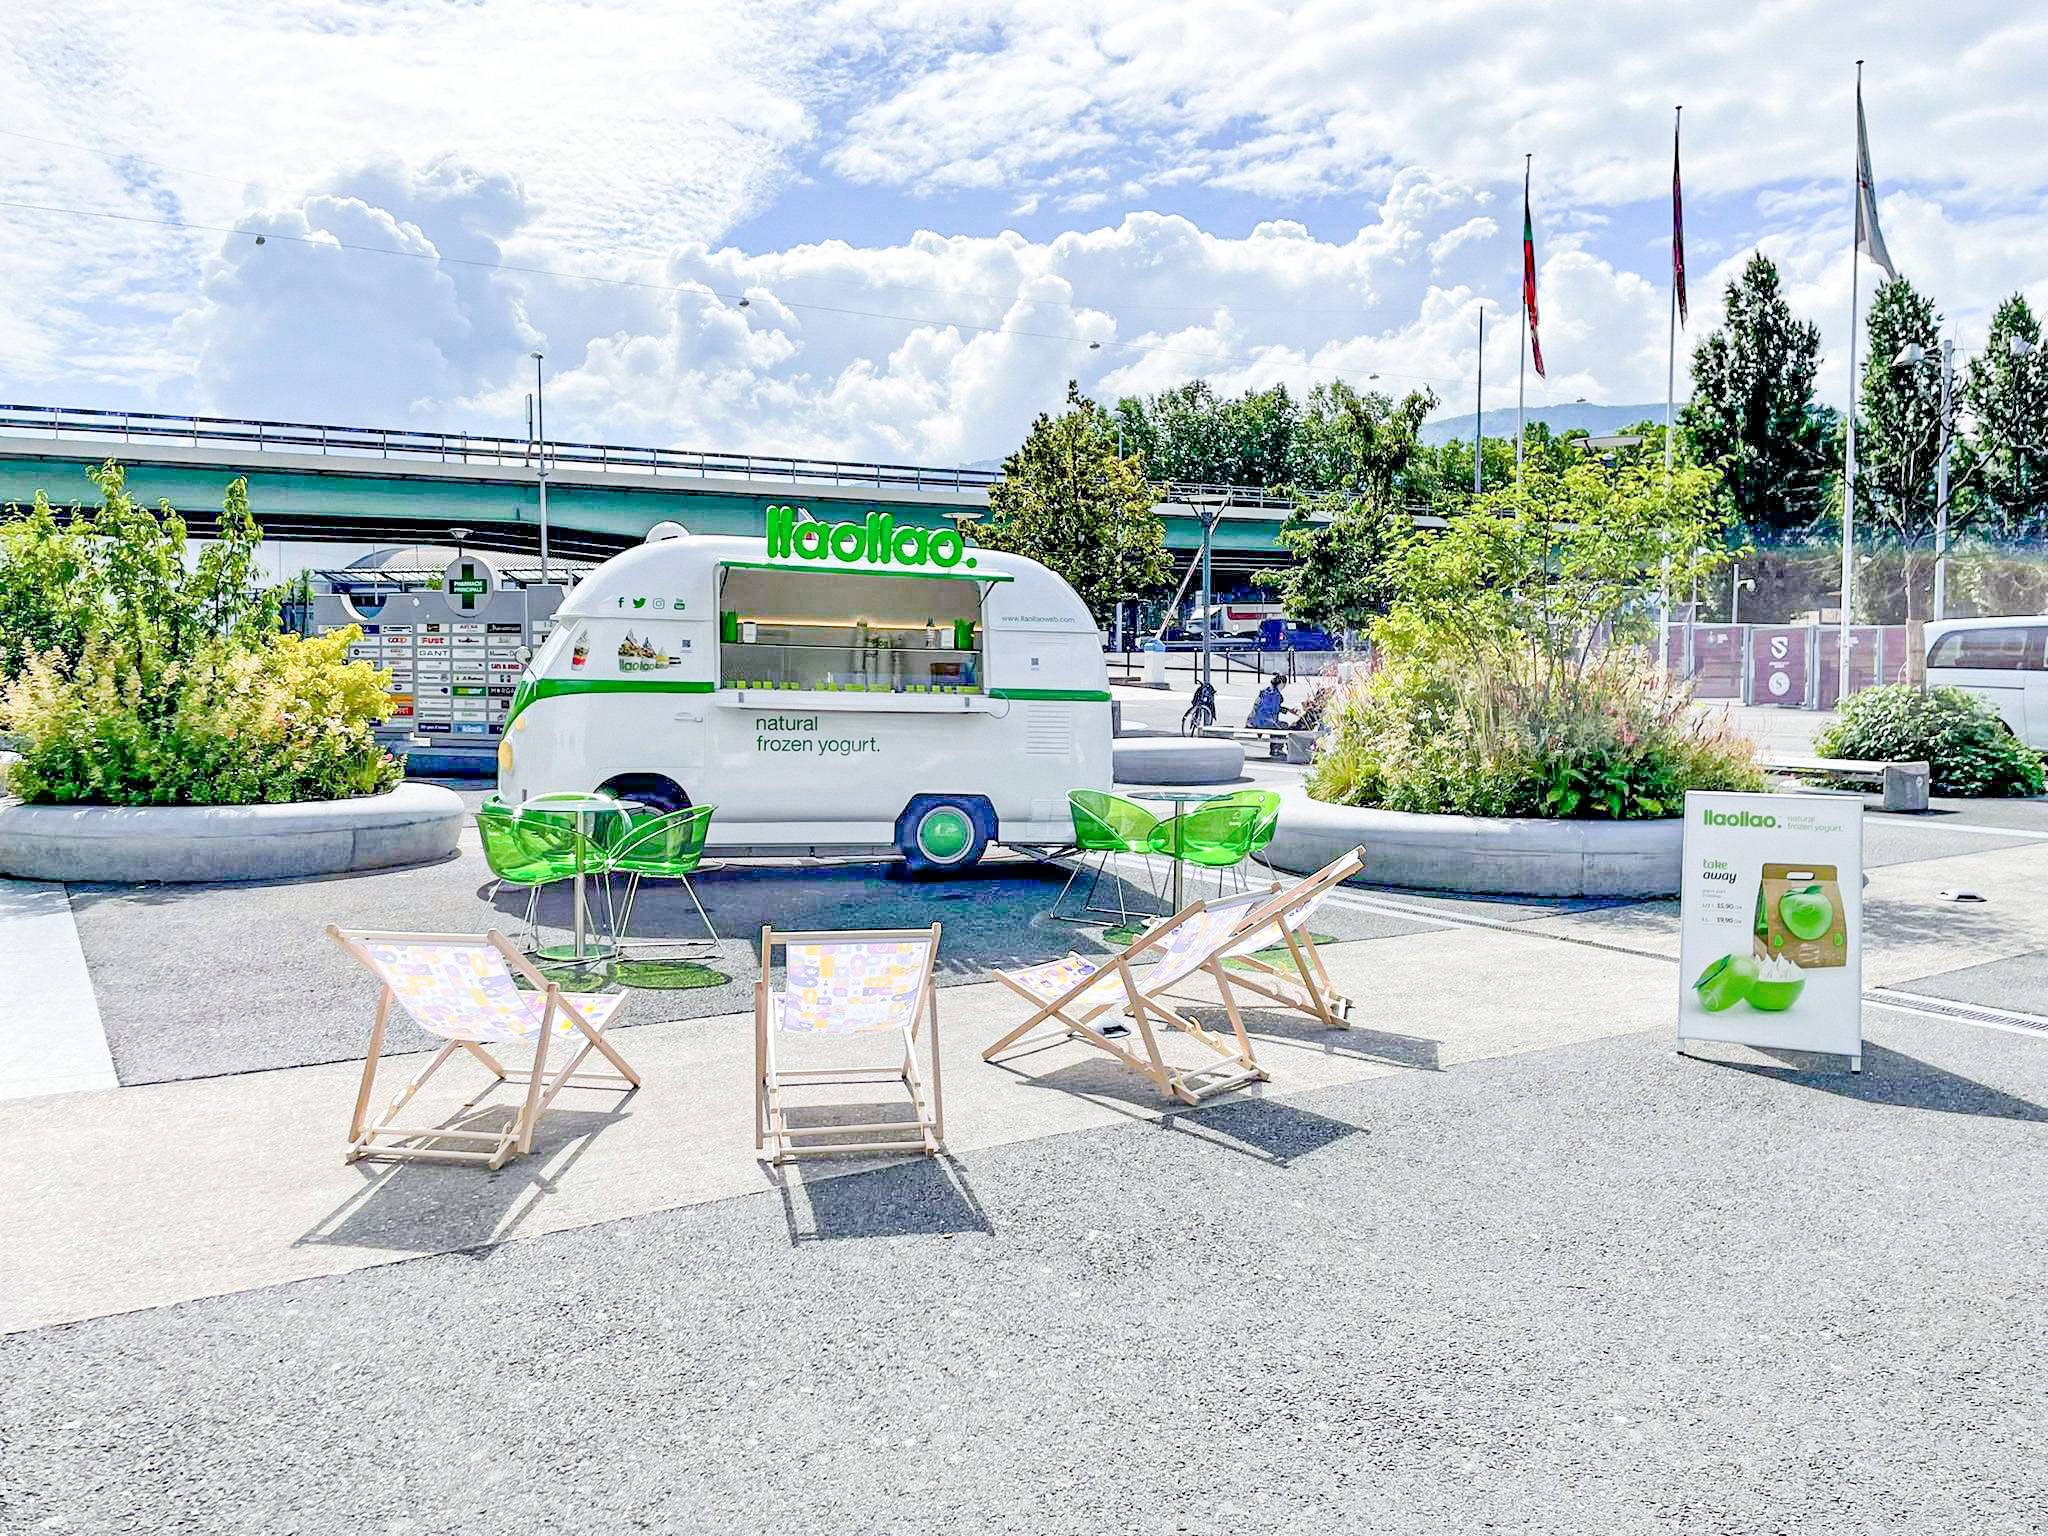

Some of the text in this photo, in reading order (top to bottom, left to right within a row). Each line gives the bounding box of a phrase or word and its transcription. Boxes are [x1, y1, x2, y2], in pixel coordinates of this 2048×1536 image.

[767, 505, 977, 569] llaollao.
[756, 715, 818, 731] natural
[756, 735, 880, 756] frozen yogurt.
[1704, 809, 1782, 829] llaollao.
[1703, 858, 1728, 870] take
[1703, 871, 1737, 884] away
